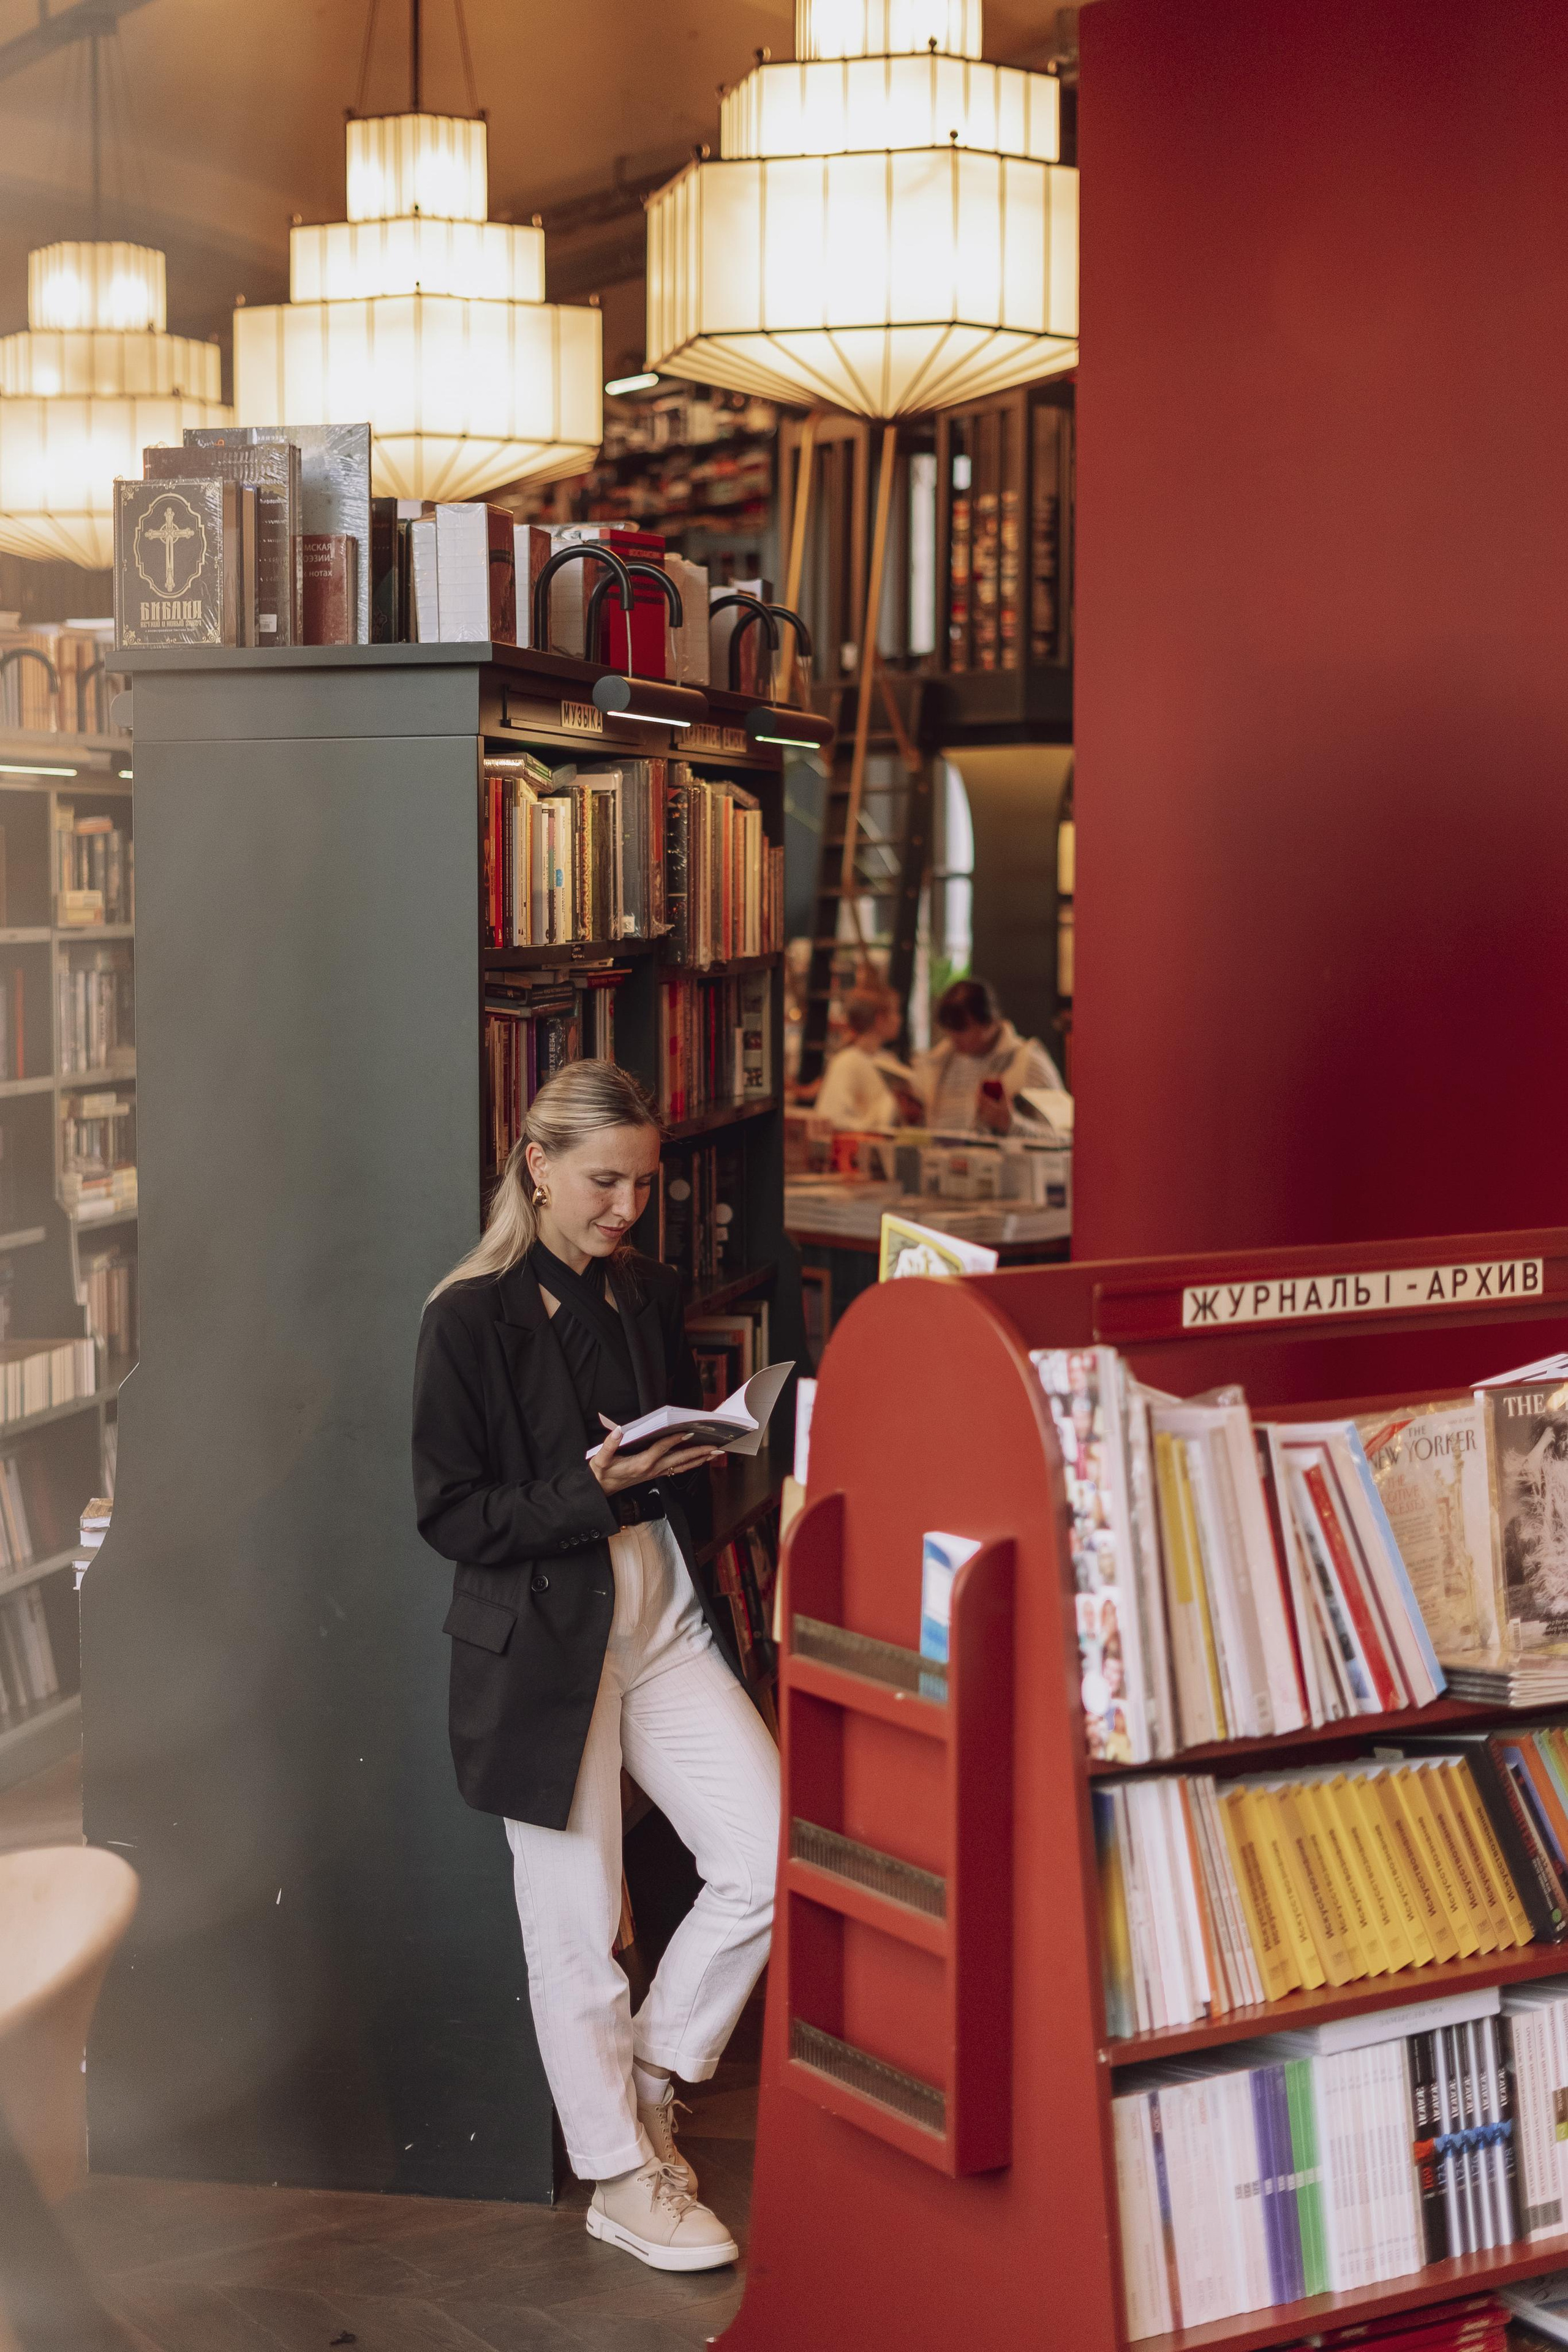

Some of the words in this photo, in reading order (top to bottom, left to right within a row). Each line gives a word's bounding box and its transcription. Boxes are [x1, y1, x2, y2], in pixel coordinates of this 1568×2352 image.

[140, 600, 202, 620] БИБЛИЯ
[564, 702, 602, 730] МУЗЫКА
[1503, 1393, 1545, 1417] THE
[1406, 1425, 1427, 1437] THE
[1408, 1429, 1477, 1463] YORKER
[1477, 1807, 1515, 1902] Искусствознание
